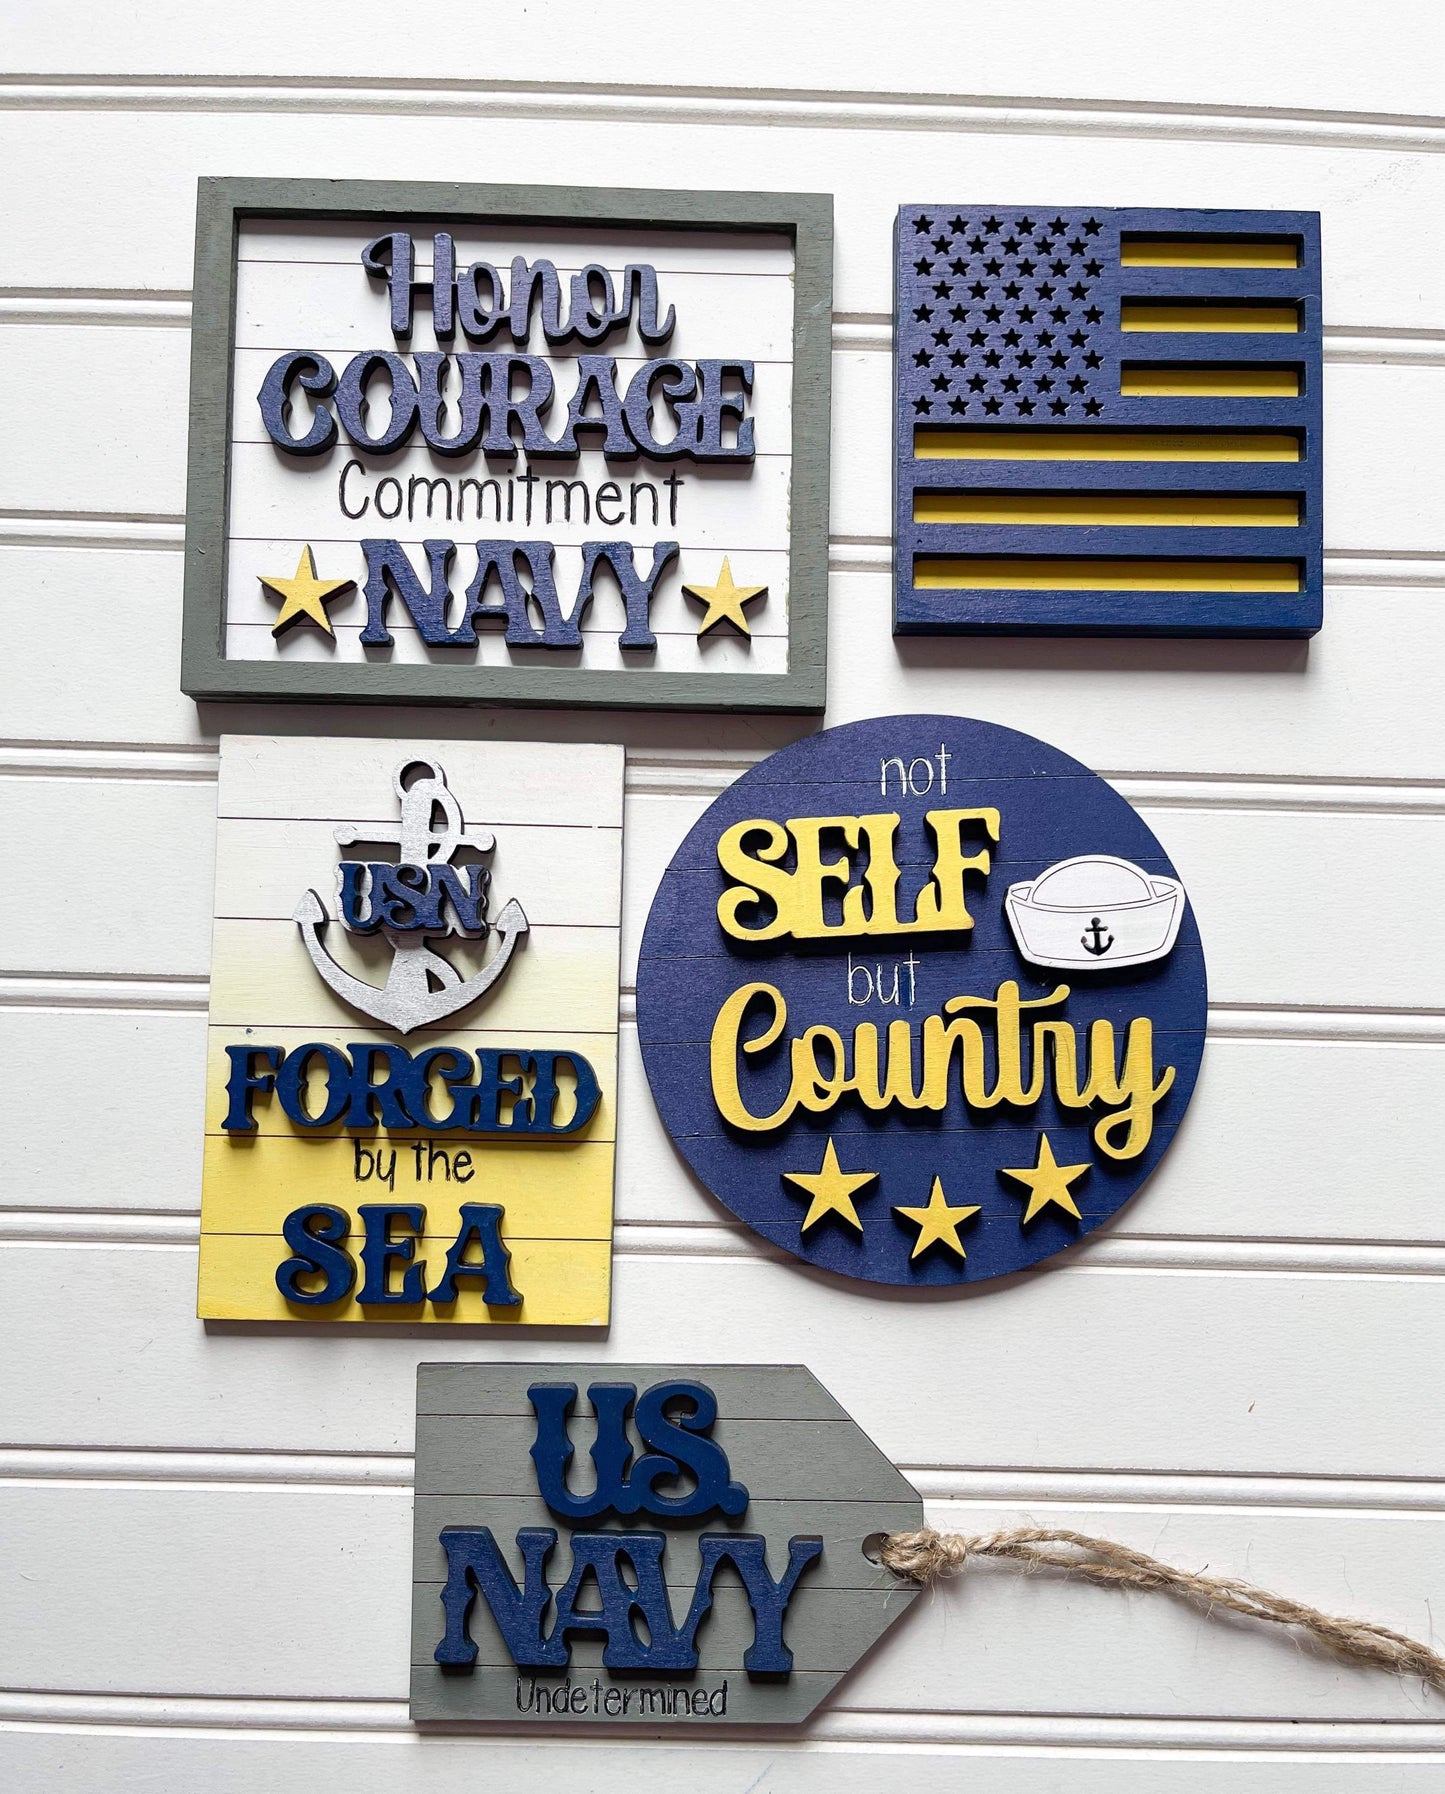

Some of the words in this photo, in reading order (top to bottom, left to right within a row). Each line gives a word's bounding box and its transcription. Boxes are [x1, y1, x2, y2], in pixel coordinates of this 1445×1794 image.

[361, 232, 676, 346] Honor
[257, 350, 756, 463] COURAGE
[338, 459, 684, 527] Commitment
[359, 539, 679, 651] NAVY
[880, 742, 952, 797] not
[337, 861, 490, 933] USN
[716, 807, 1001, 942] SELF
[847, 953, 921, 1006] but
[221, 1043, 603, 1135] FORGED
[710, 980, 1176, 1160] Country
[354, 1138, 397, 1191] by
[412, 1140, 475, 1182] the
[276, 1202, 524, 1306] SEA
[434, 1525, 823, 1673] NAVY
[515, 1677, 728, 1717] Undetermined
